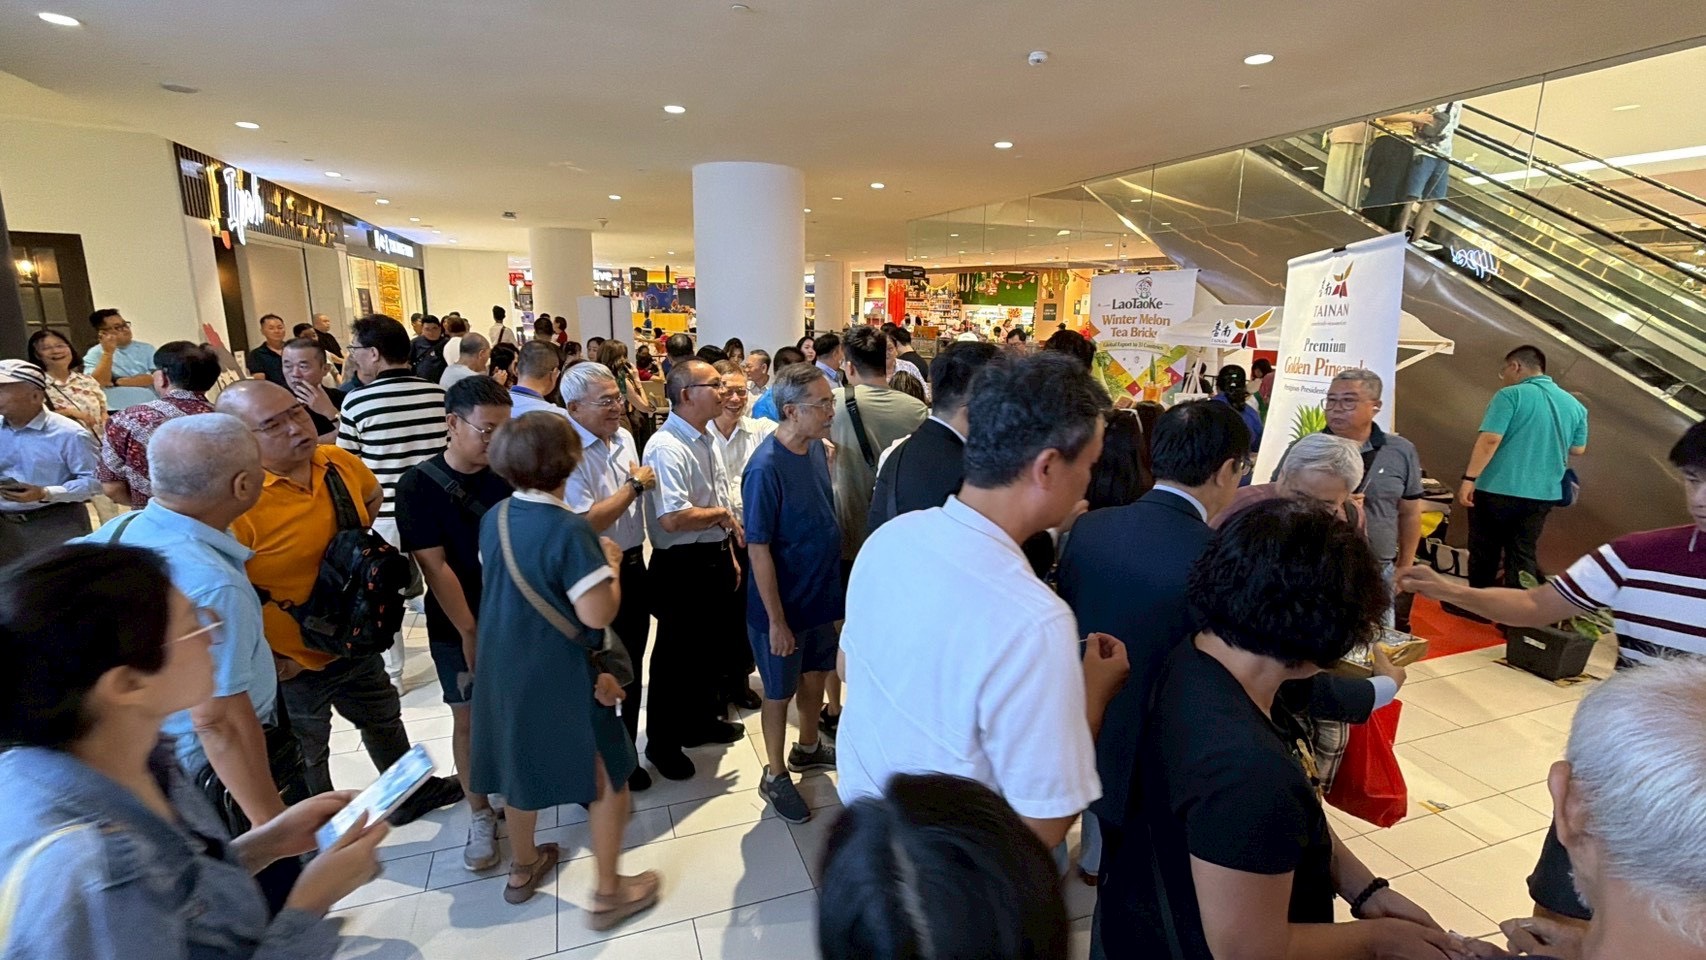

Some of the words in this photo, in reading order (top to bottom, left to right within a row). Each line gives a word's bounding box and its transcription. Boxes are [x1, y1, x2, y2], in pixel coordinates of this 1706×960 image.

[1112, 298, 1163, 309] LaoTaoKe
[1313, 303, 1349, 318] TAINAN
[1102, 314, 1137, 326] Winter
[1139, 314, 1171, 326] Melon
[1111, 327, 1128, 337] Tea
[1304, 338, 1346, 352] Premium
[1284, 356, 1311, 375] Golden
